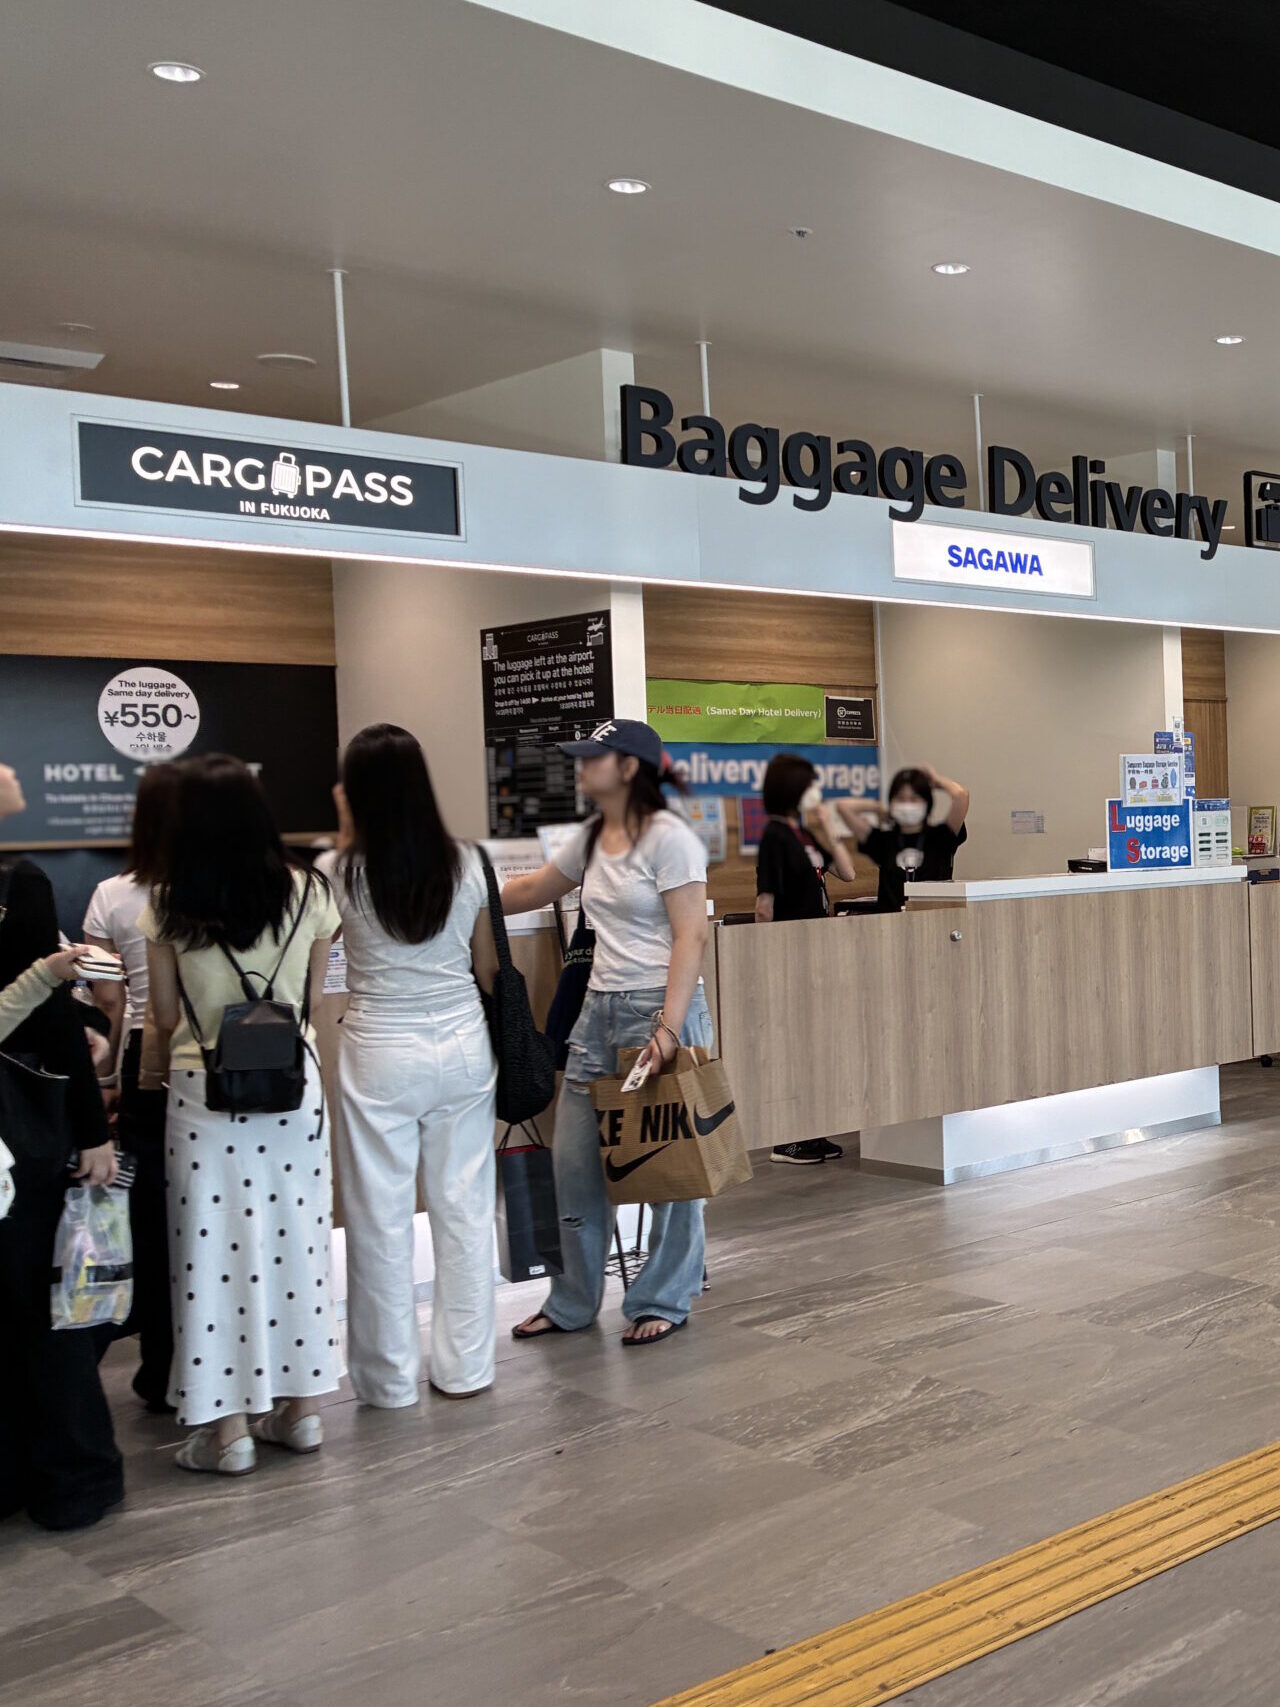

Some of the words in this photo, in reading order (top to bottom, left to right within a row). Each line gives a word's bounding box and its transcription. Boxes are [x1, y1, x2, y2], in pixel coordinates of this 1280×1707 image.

[620, 384, 967, 522] Baggage
[988, 446, 1227, 560] Delivery
[240, 501, 256, 514] IN
[261, 502, 330, 520] FUKUOKA
[947, 544, 1043, 577] SAGAWA
[493, 661, 506, 672] The
[506, 659, 533, 672] luggage
[534, 656, 546, 667] left
[547, 655, 555, 665] at
[556, 653, 568, 664] the
[118, 680, 136, 688] The
[139, 681, 177, 690] luggage
[493, 676, 506, 687] you
[507, 674, 520, 684] can
[520, 670, 534, 684] pick
[535, 669, 541, 680] it
[542, 670, 551, 681] up
[552, 667, 560, 678] at
[561, 665, 573, 677] the
[107, 689, 134, 697] Same
[136, 690, 152, 699] day
[154, 690, 190, 700] delivery
[739, 707, 756, 719] Day
[758, 708, 783, 717] Hotel
[136, 732, 167, 743] 수하물
[44, 763, 124, 782] HOTEL
[674, 751, 767, 790] elivery
[815, 763, 880, 796] orage
[1111, 804, 1180, 832] Luggage
[1127, 838, 1189, 863] Storage
[595, 1108, 625, 1148] KE
[640, 1101, 697, 1144] NIK
